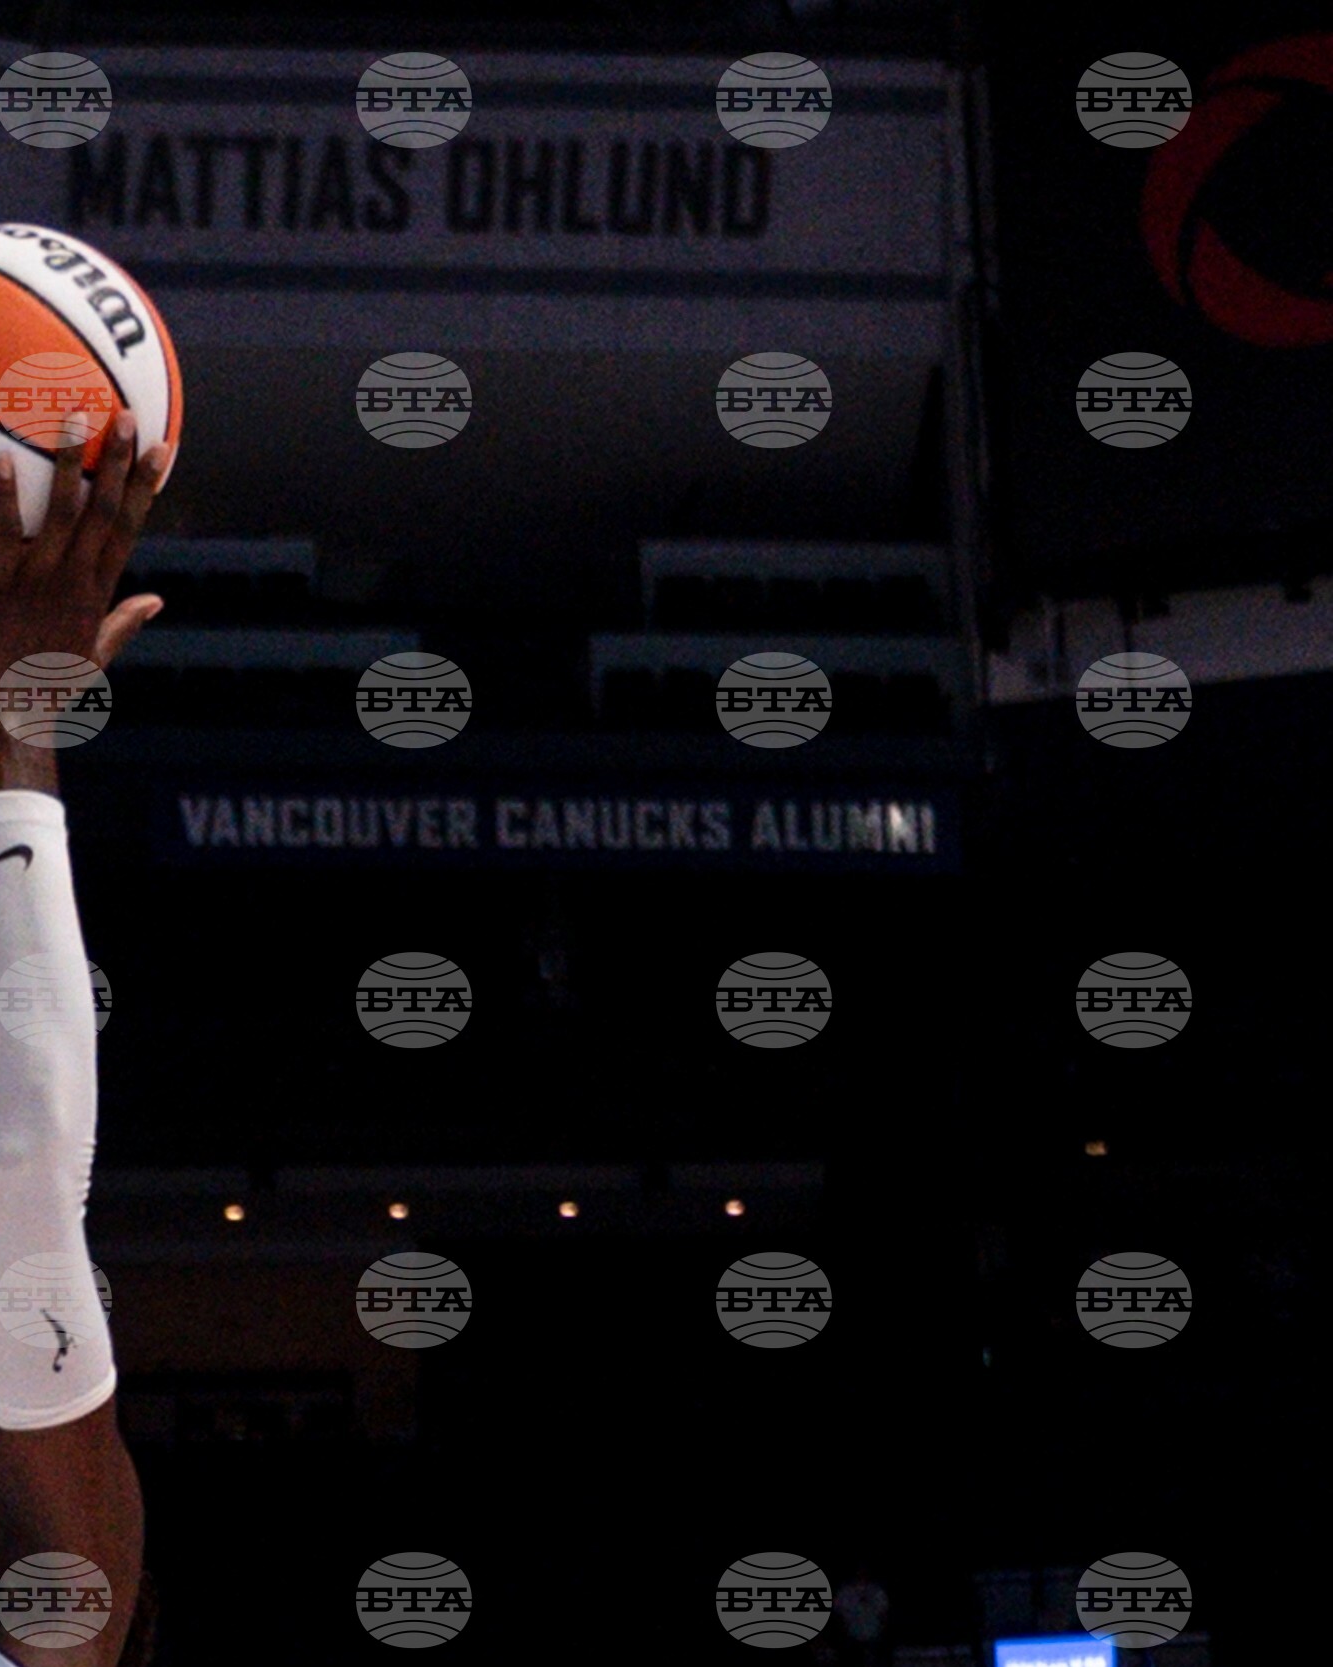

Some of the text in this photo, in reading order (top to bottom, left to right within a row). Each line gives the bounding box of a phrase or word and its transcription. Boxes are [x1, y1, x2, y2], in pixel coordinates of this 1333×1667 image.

[66, 132, 414, 232] MATTIAS
[179, 793, 937, 855] VANCOUVER CANUCKS ALUMNI
